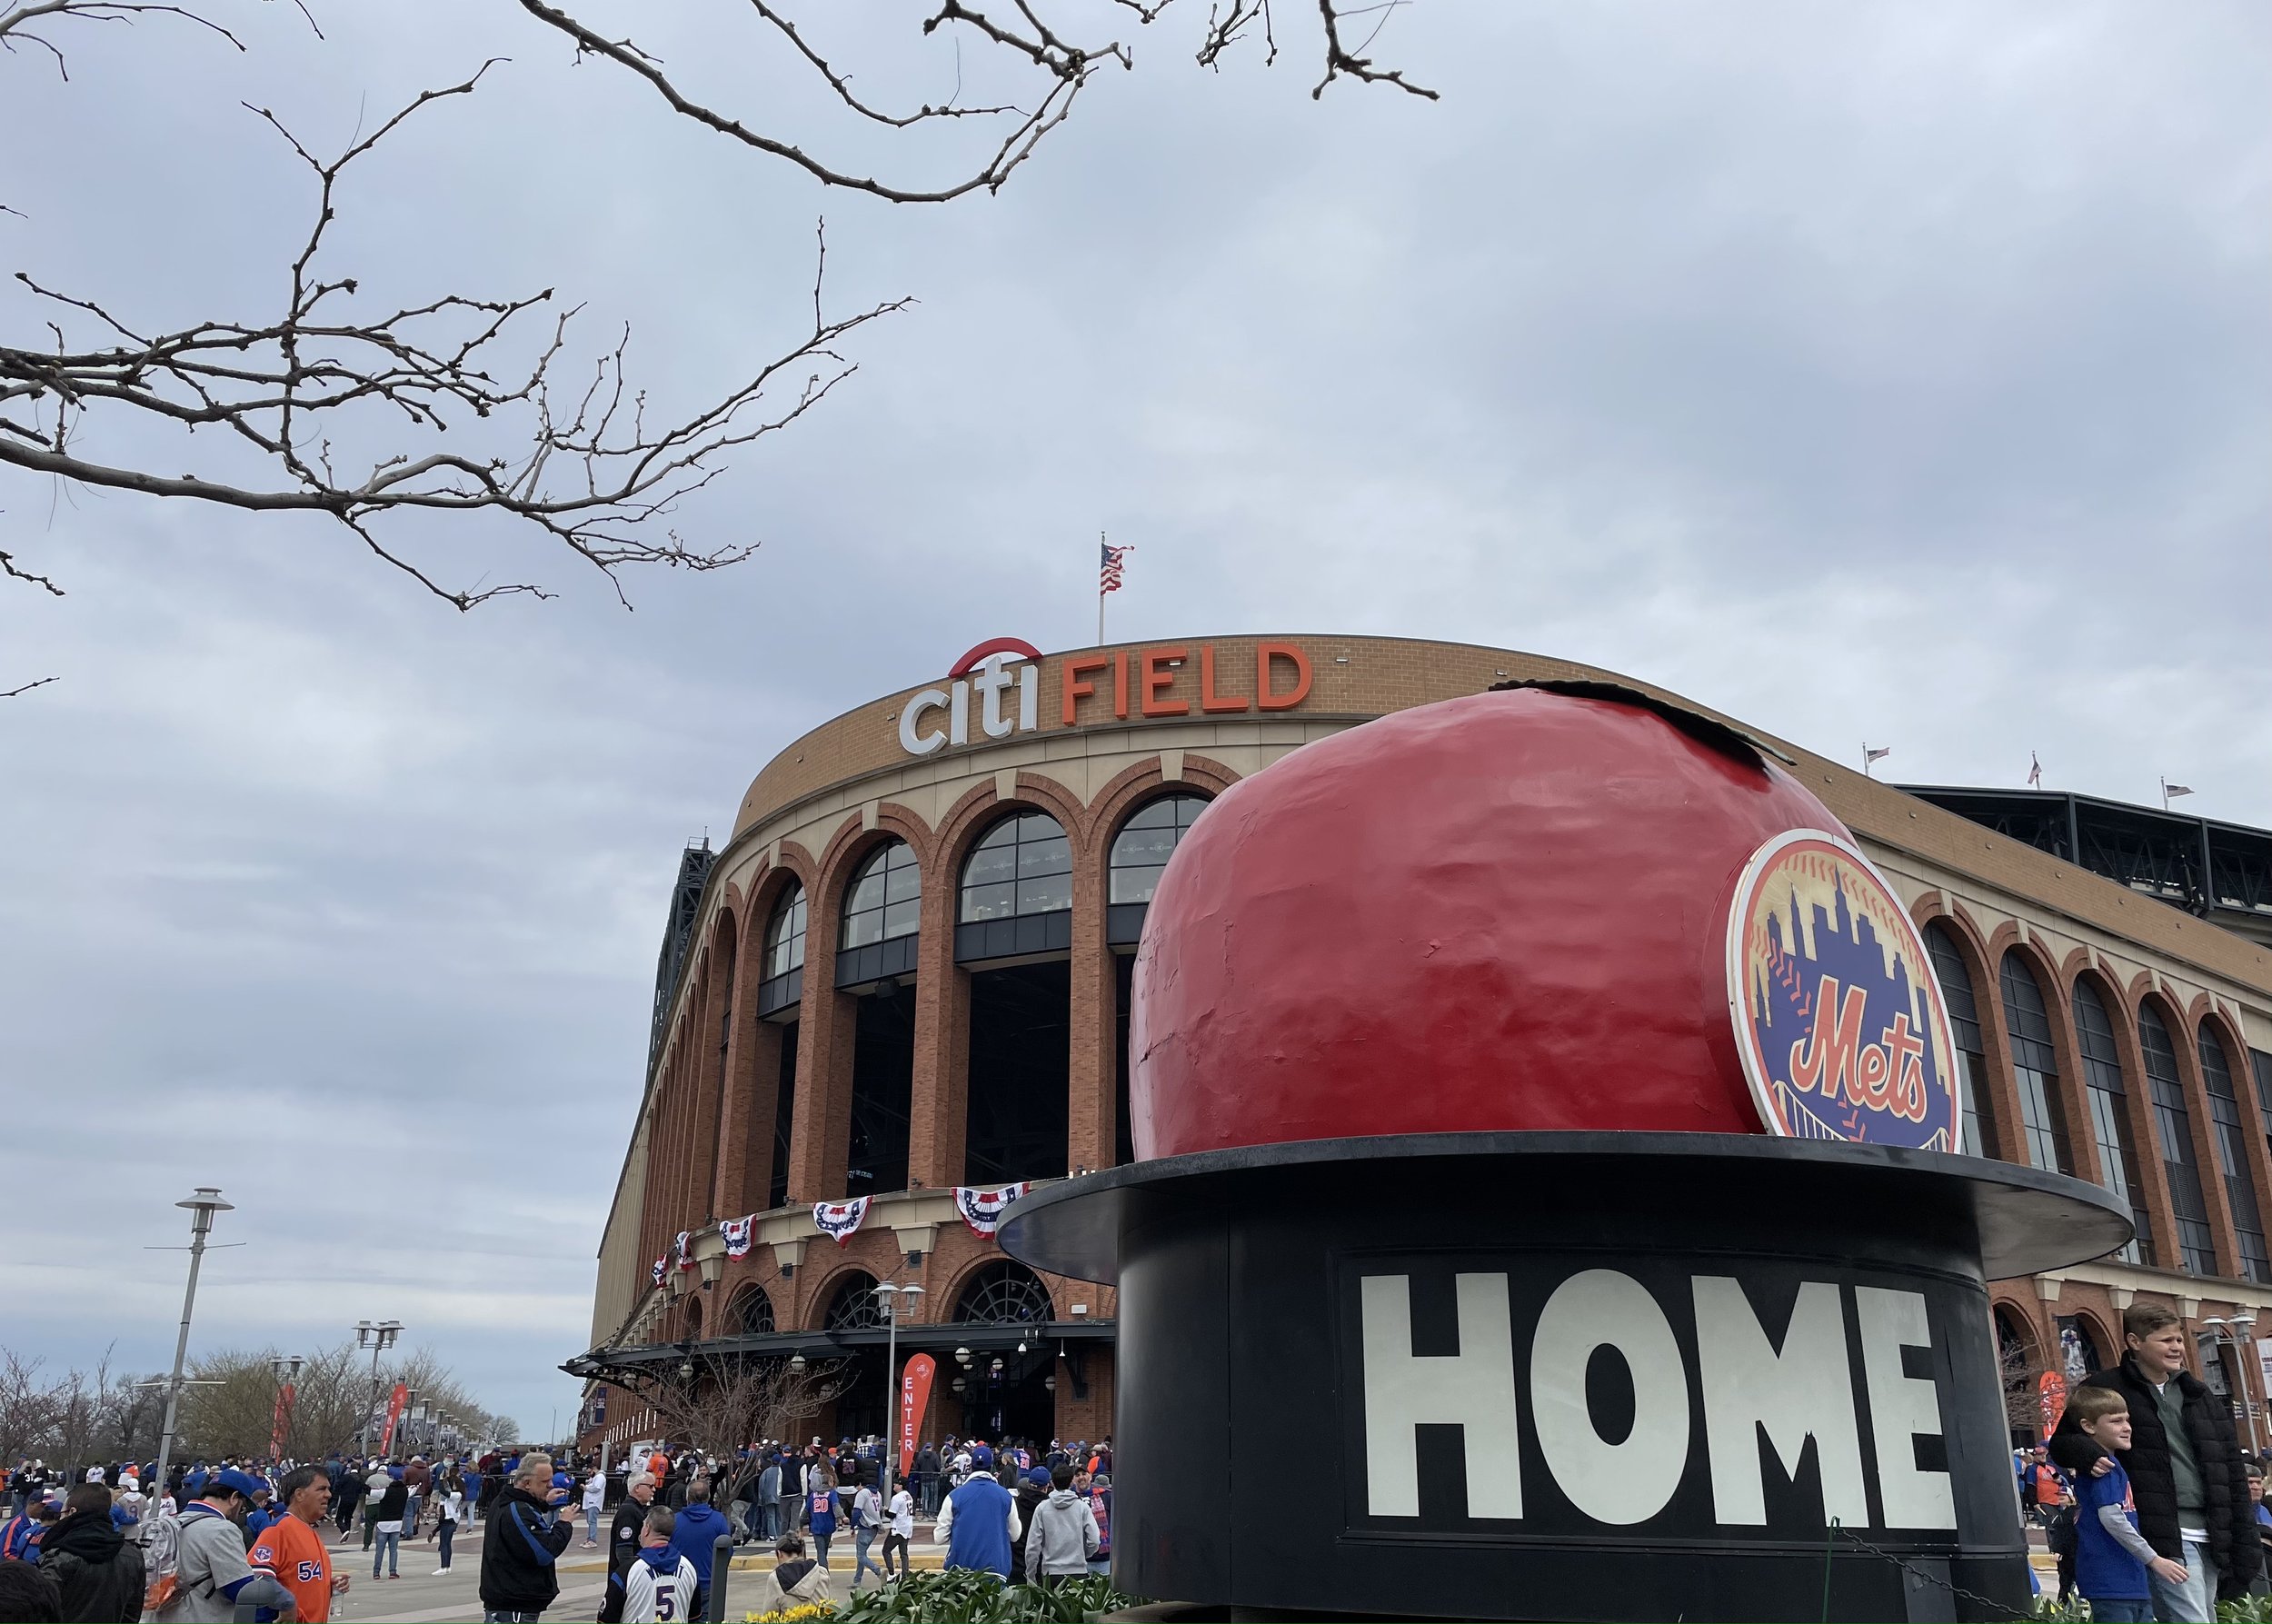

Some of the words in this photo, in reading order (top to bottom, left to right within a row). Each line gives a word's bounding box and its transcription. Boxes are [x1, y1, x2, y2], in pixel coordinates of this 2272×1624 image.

[899, 655, 1039, 756] citi
[1062, 643, 1312, 726] FIELD
[1789, 974, 1928, 1123] Mets
[904, 1377, 913, 1451] ENTER
[1360, 1269, 1958, 1529] HOME
[813, 1499, 828, 1512] 20
[298, 1560, 323, 1582] 54
[655, 1585, 675, 1621] 5
